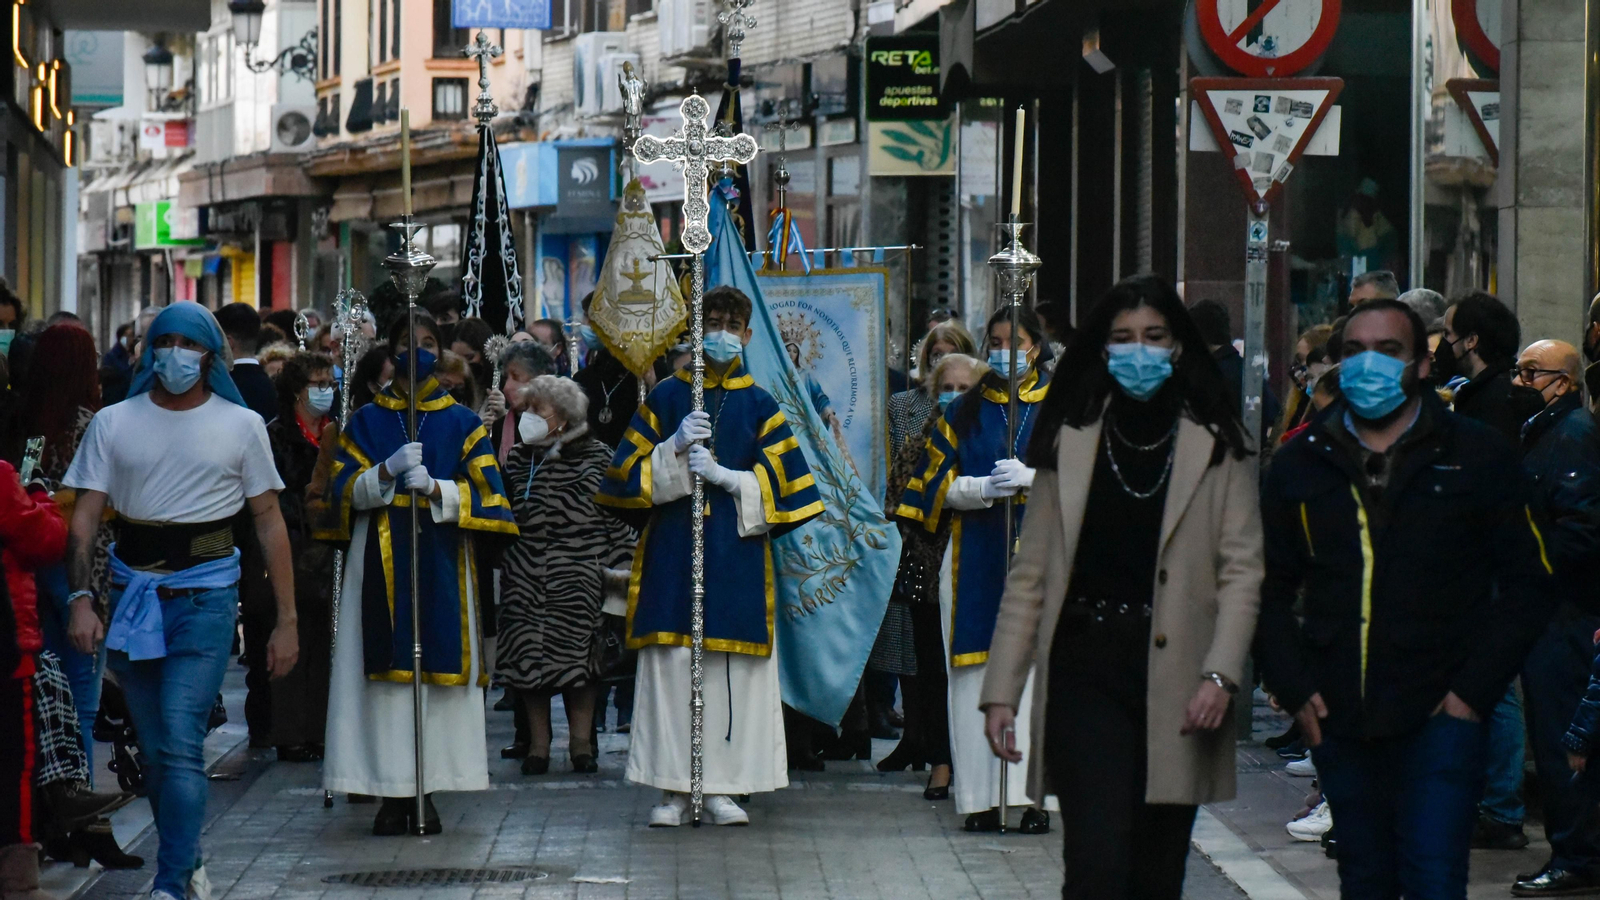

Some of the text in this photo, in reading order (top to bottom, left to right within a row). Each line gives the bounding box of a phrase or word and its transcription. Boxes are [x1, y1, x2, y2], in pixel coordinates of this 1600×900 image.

[871, 50, 932, 71] RETA
[884, 86, 933, 97] apuestas
[879, 95, 938, 108] deportivas
[813, 307, 846, 341] NOSOTROS
[841, 340, 853, 356] QUE
[847, 357, 859, 407] RECURRIMOS
[842, 414, 854, 430] VOS
